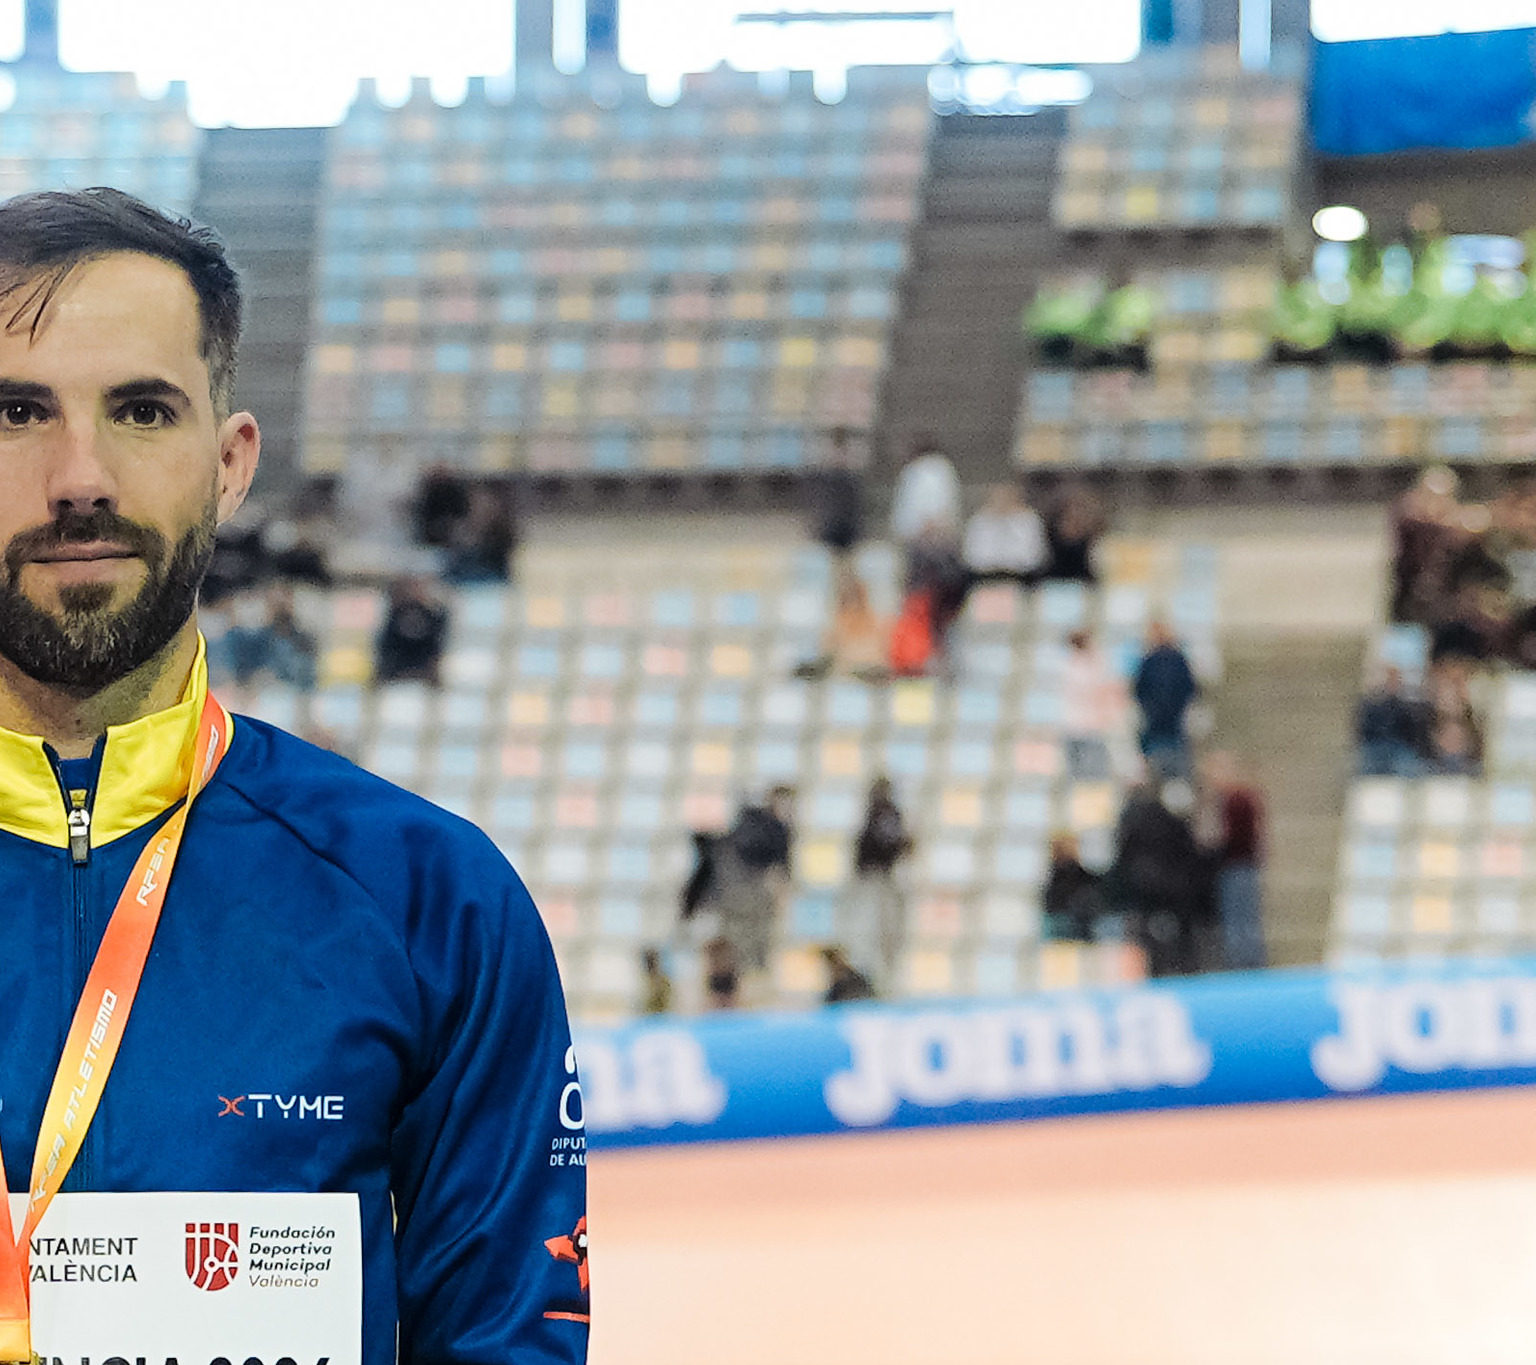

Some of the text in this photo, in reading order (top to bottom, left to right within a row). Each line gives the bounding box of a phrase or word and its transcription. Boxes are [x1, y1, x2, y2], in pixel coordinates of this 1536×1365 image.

[64, 988, 118, 1130] ATLETISMO
[249, 1226, 336, 1239] Fundación
[249, 1242, 333, 1258] Deportiva
[30, 1260, 138, 1282] ALÈNCIA
[249, 1258, 331, 1274] Municipal
[248, 1274, 320, 1288] València
